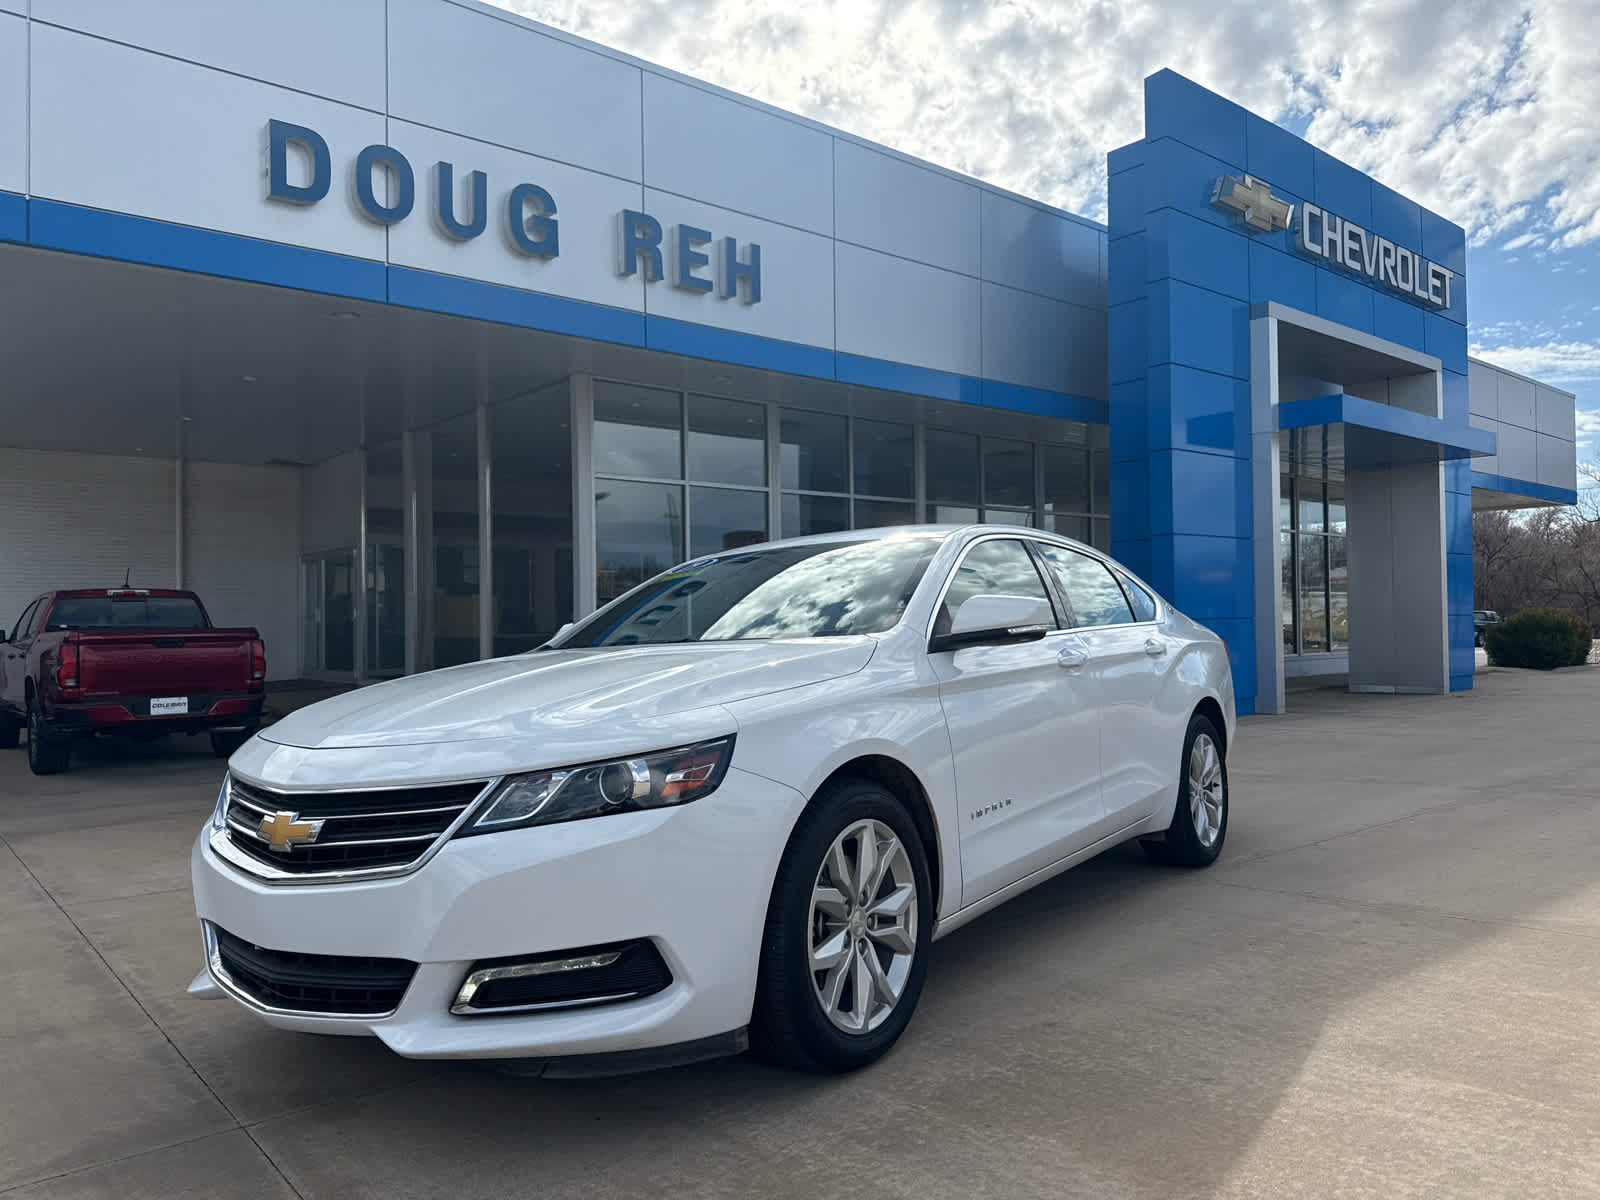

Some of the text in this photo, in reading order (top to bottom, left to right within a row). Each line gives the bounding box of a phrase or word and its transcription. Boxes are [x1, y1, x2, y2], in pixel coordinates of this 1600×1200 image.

[265, 118, 762, 305] DOUG REH
[1300, 201, 1454, 309] CHEVROLET
[970, 799, 1012, 821] IMPALA
